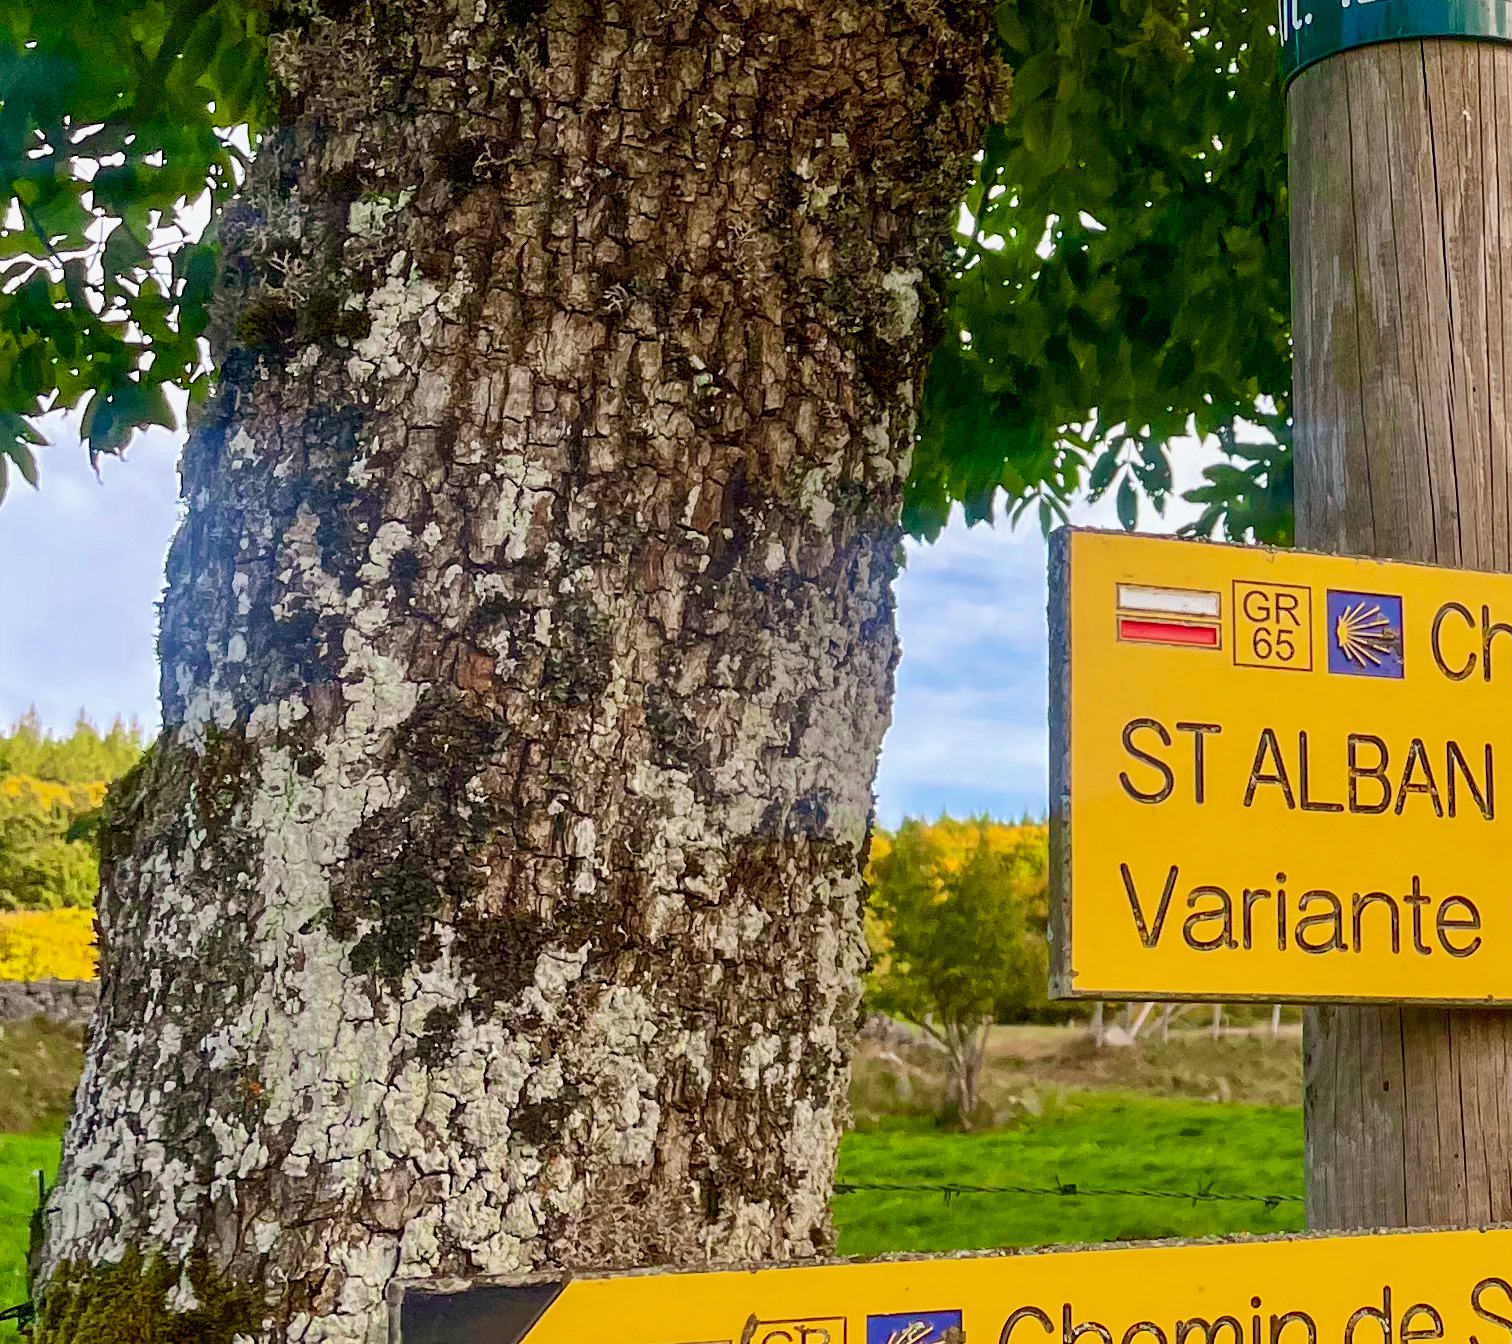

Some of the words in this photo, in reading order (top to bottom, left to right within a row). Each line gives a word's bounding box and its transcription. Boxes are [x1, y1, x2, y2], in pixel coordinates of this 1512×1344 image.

[1243, 591, 1301, 626] GR
[1251, 628, 1295, 661] 65
[1119, 718, 1221, 804] ST
[1244, 728, 1494, 820] ALBAN
[1120, 863, 1481, 957] Variante
